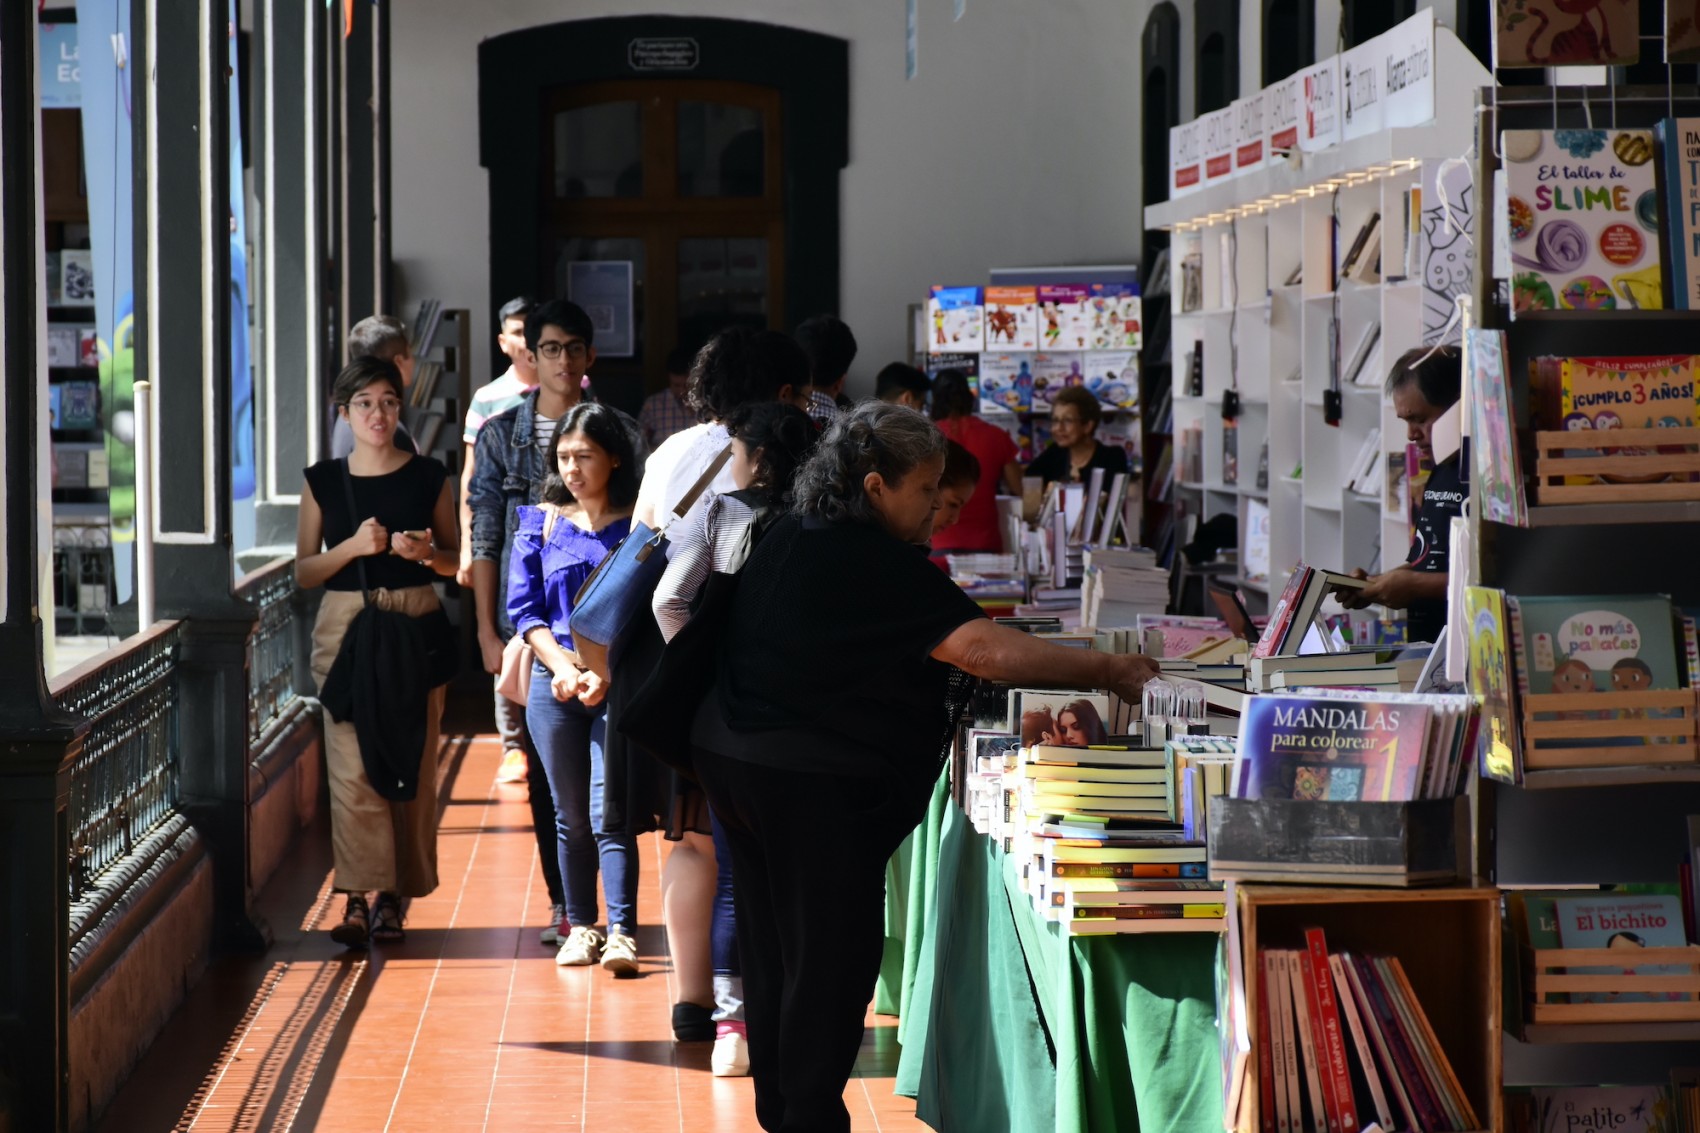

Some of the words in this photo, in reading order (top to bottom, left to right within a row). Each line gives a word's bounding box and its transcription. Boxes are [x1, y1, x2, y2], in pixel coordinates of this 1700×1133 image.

[1537, 165, 1559, 181] El
[1563, 166, 1604, 180] taller
[1609, 166, 1627, 179] de
[1535, 184, 1632, 212] SLIME
[1573, 390, 1632, 411] ¡CUMPLO
[1632, 383, 1647, 405] 3
[1649, 381, 1694, 401] AÑOS!
[1570, 621, 1594, 637] No
[1599, 620, 1634, 636] más
[1569, 637, 1639, 657] pañales
[1272, 706, 1401, 732] MANDALAS
[1270, 733, 1307, 752] para
[1311, 729, 1378, 750] colorear
[1379, 736, 1399, 801] 1
[1576, 914, 1594, 930] El
[1599, 912, 1667, 930] bichito
[1566, 1107, 1626, 1133] patito
